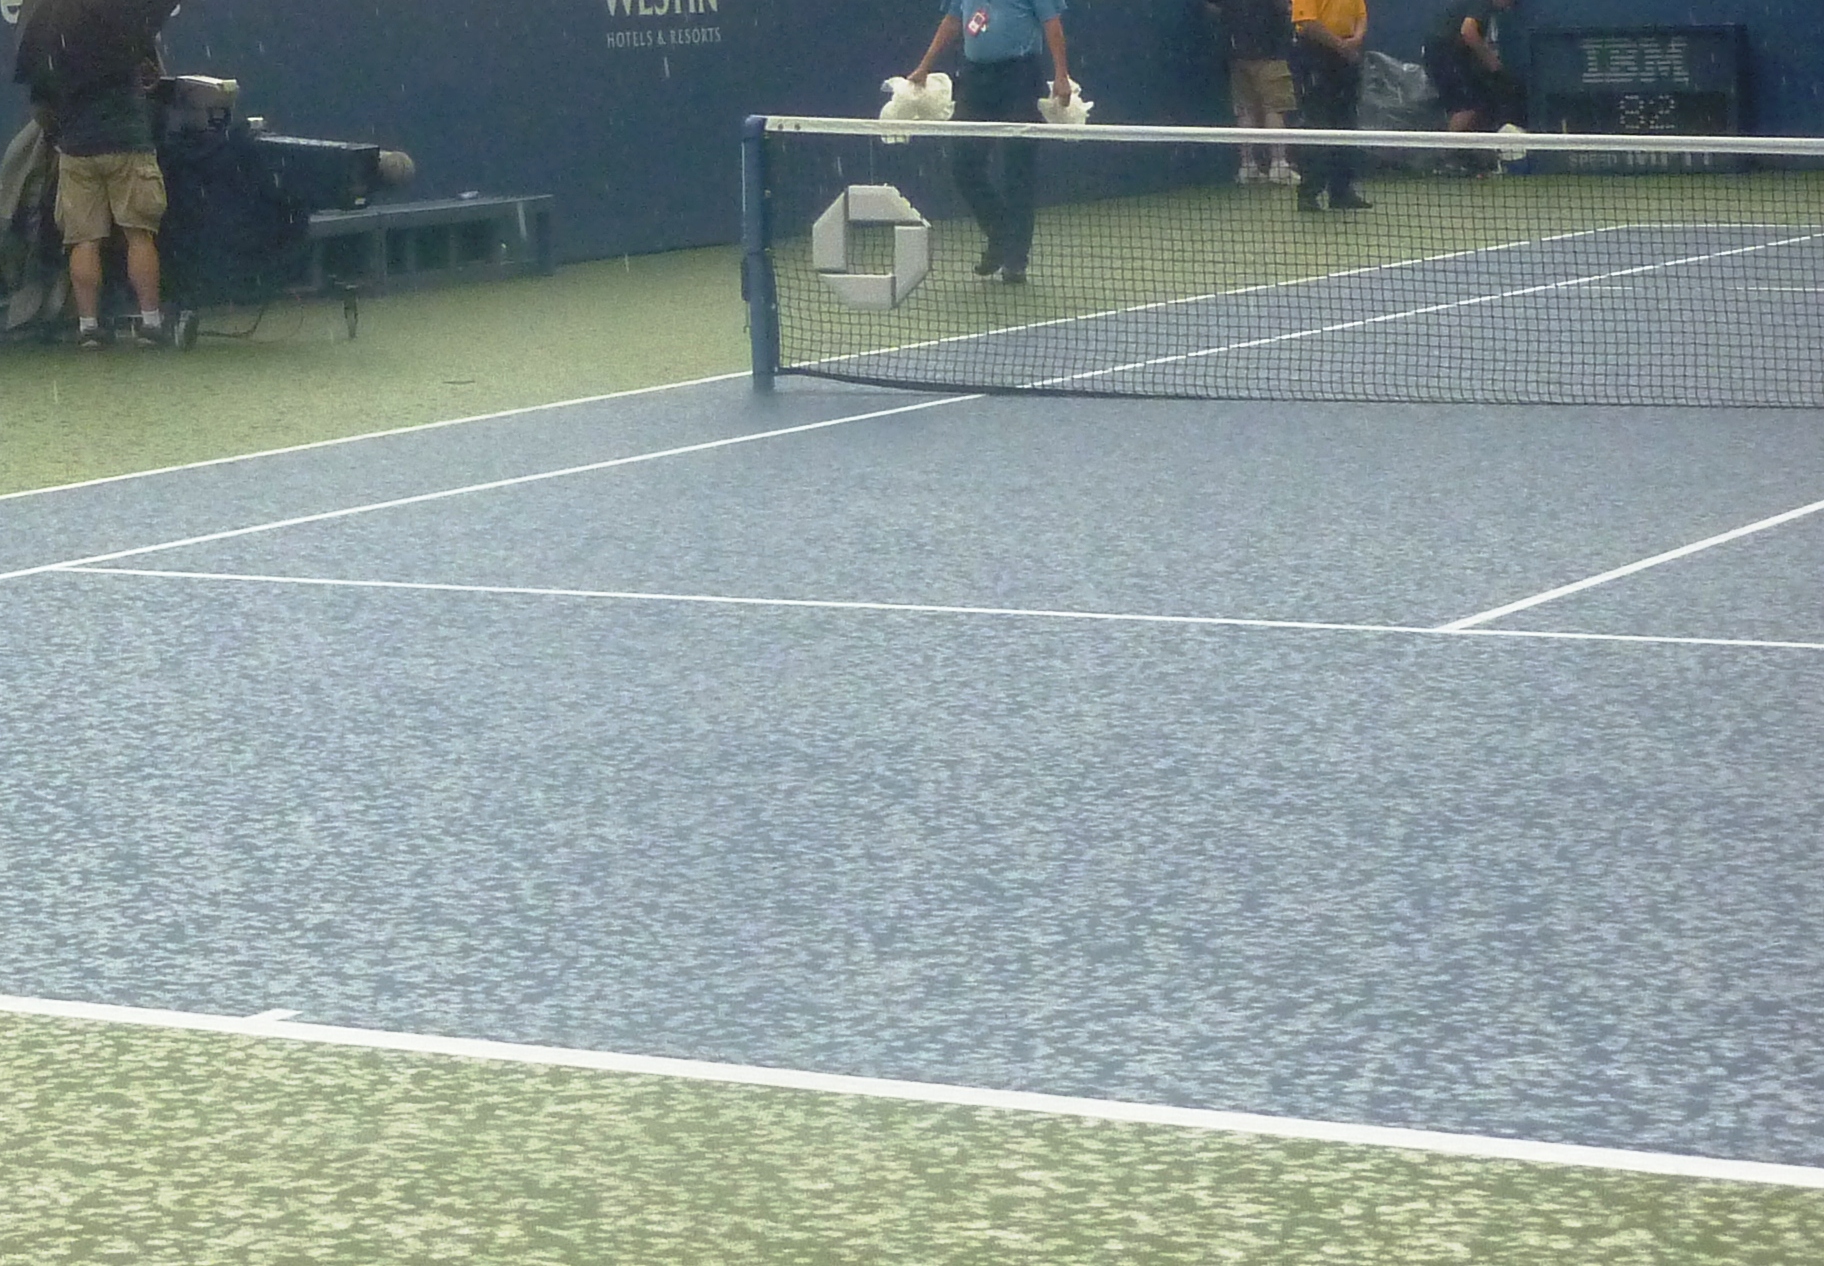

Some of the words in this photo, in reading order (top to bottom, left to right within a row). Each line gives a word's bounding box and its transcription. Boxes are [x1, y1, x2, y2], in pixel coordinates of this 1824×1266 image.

[607, 30, 653, 48] HOTELS
[670, 27, 722, 46] RESORTS
[1580, 37, 1689, 83] IBM
[1619, 94, 1676, 130] 82
